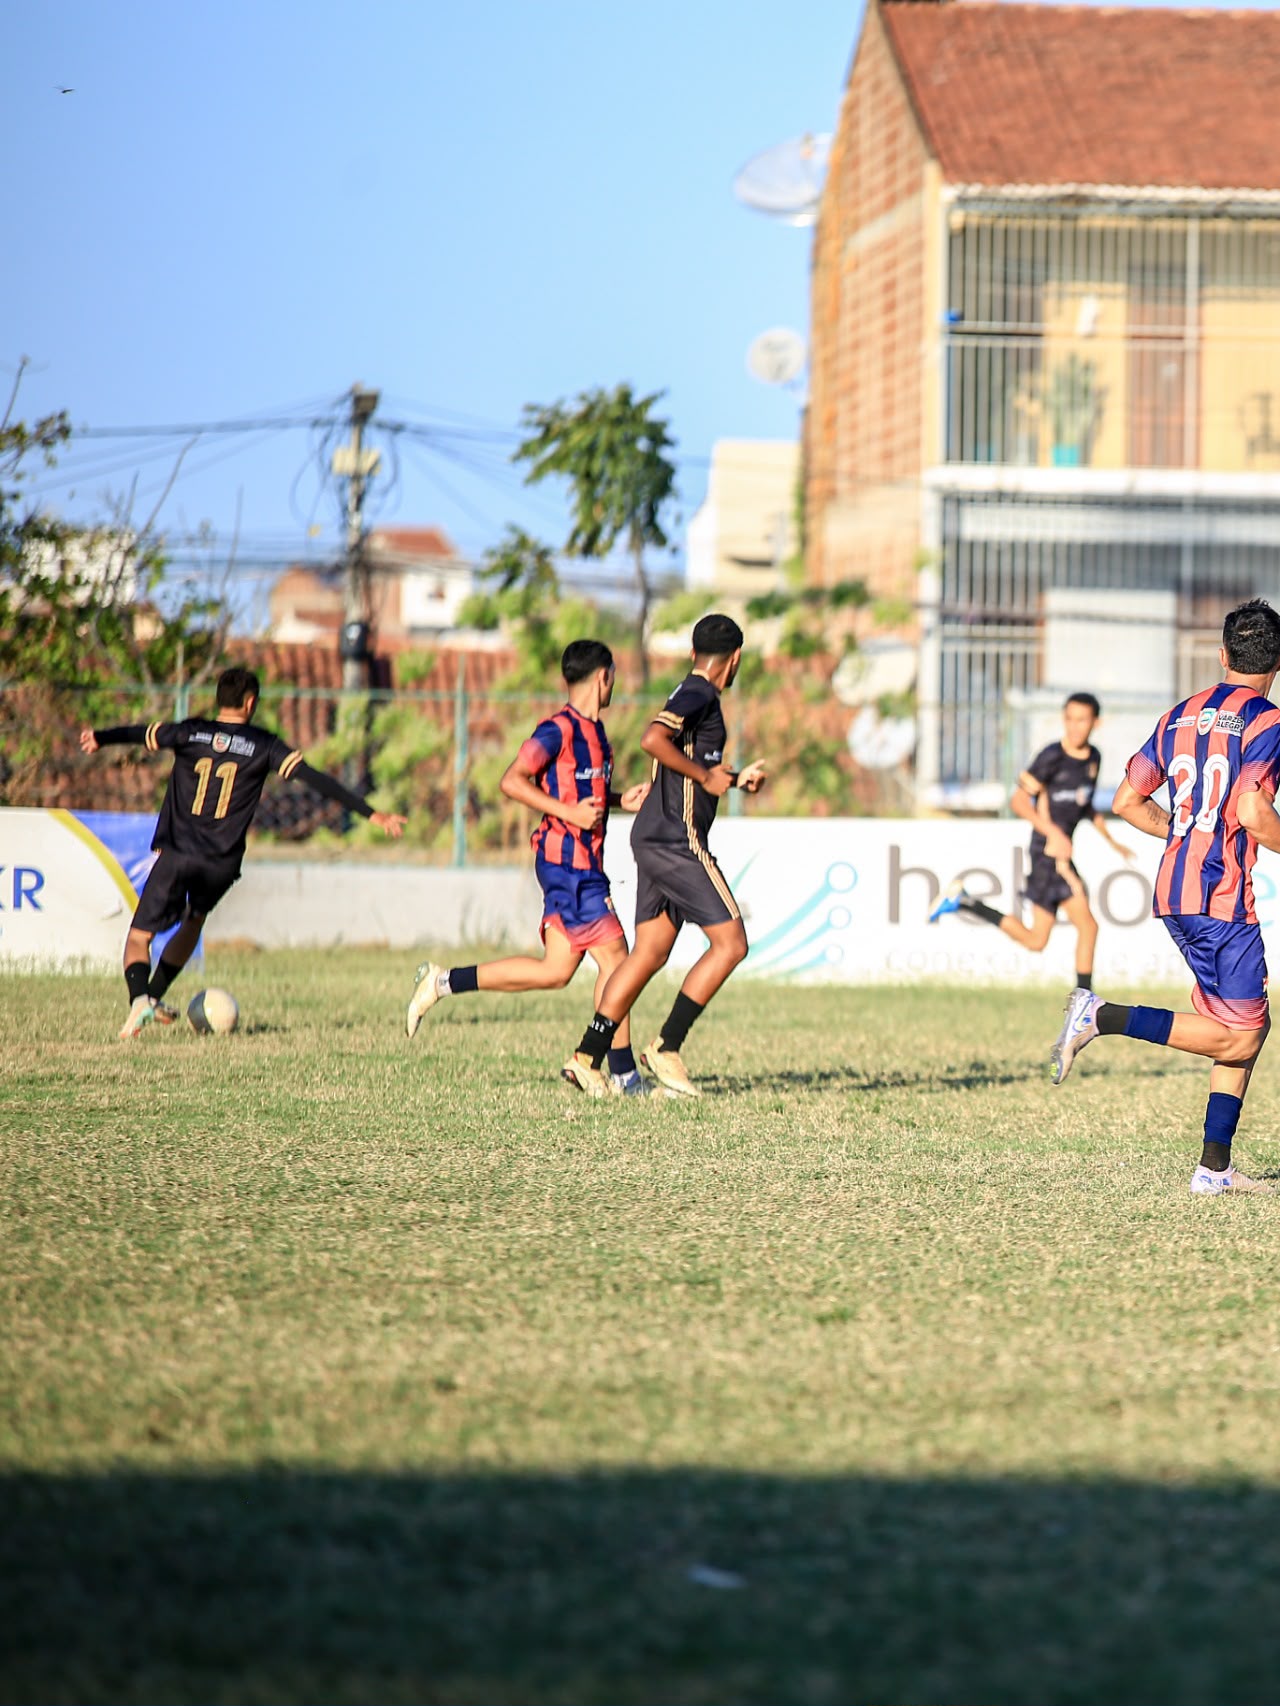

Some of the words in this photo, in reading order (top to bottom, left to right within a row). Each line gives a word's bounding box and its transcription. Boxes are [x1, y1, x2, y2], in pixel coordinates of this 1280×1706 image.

[191, 756, 238, 820] 11
[1167, 753, 1231, 837] 20
[0, 866, 45, 910] R
